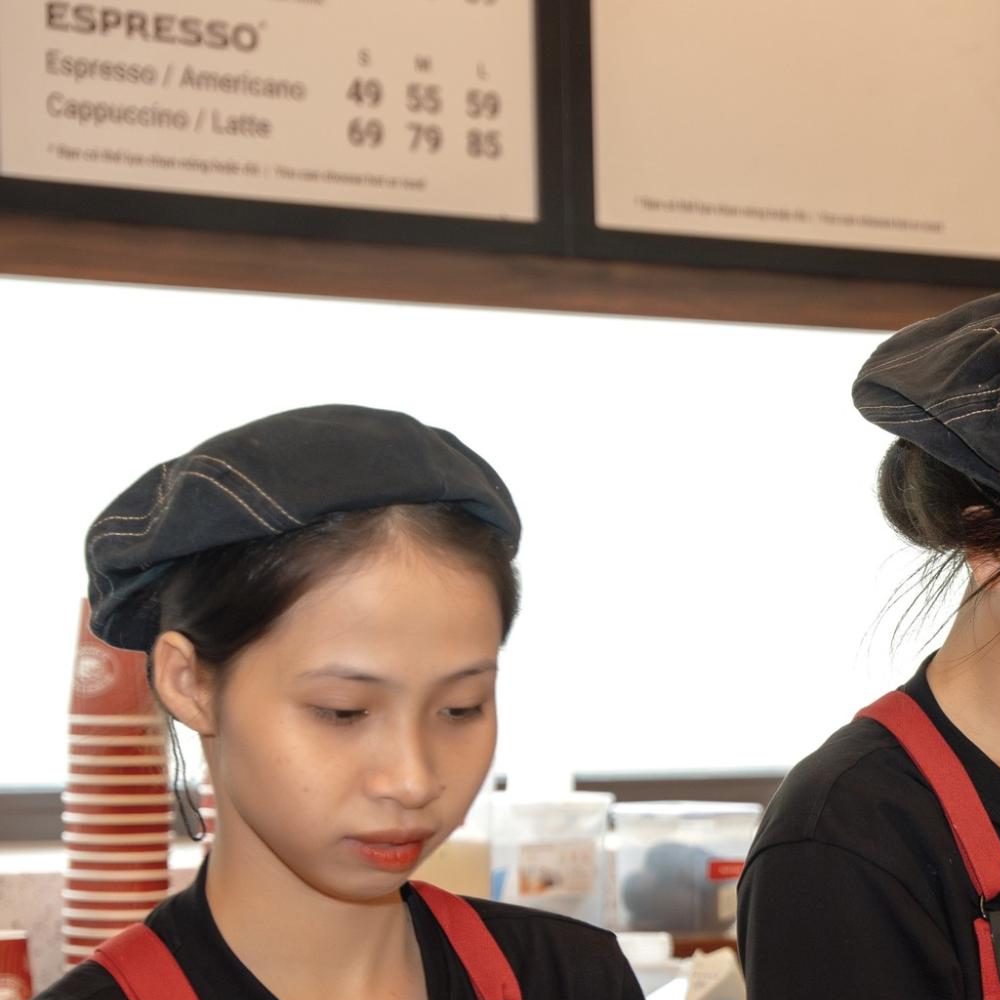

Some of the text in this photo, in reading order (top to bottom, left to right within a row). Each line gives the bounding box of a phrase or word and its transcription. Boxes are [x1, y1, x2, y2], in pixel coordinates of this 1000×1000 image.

[44, 2, 259, 52] ESPRESSO
[45, 49, 156, 85] Espresso
[180, 67, 306, 101] Americano
[357, 48, 488, 80] S M L
[46, 92, 189, 132] Cappuccino
[211, 110, 271, 138] Latte
[347, 79, 501, 120] 49 55 59
[347, 119, 502, 159] 69 79 85
